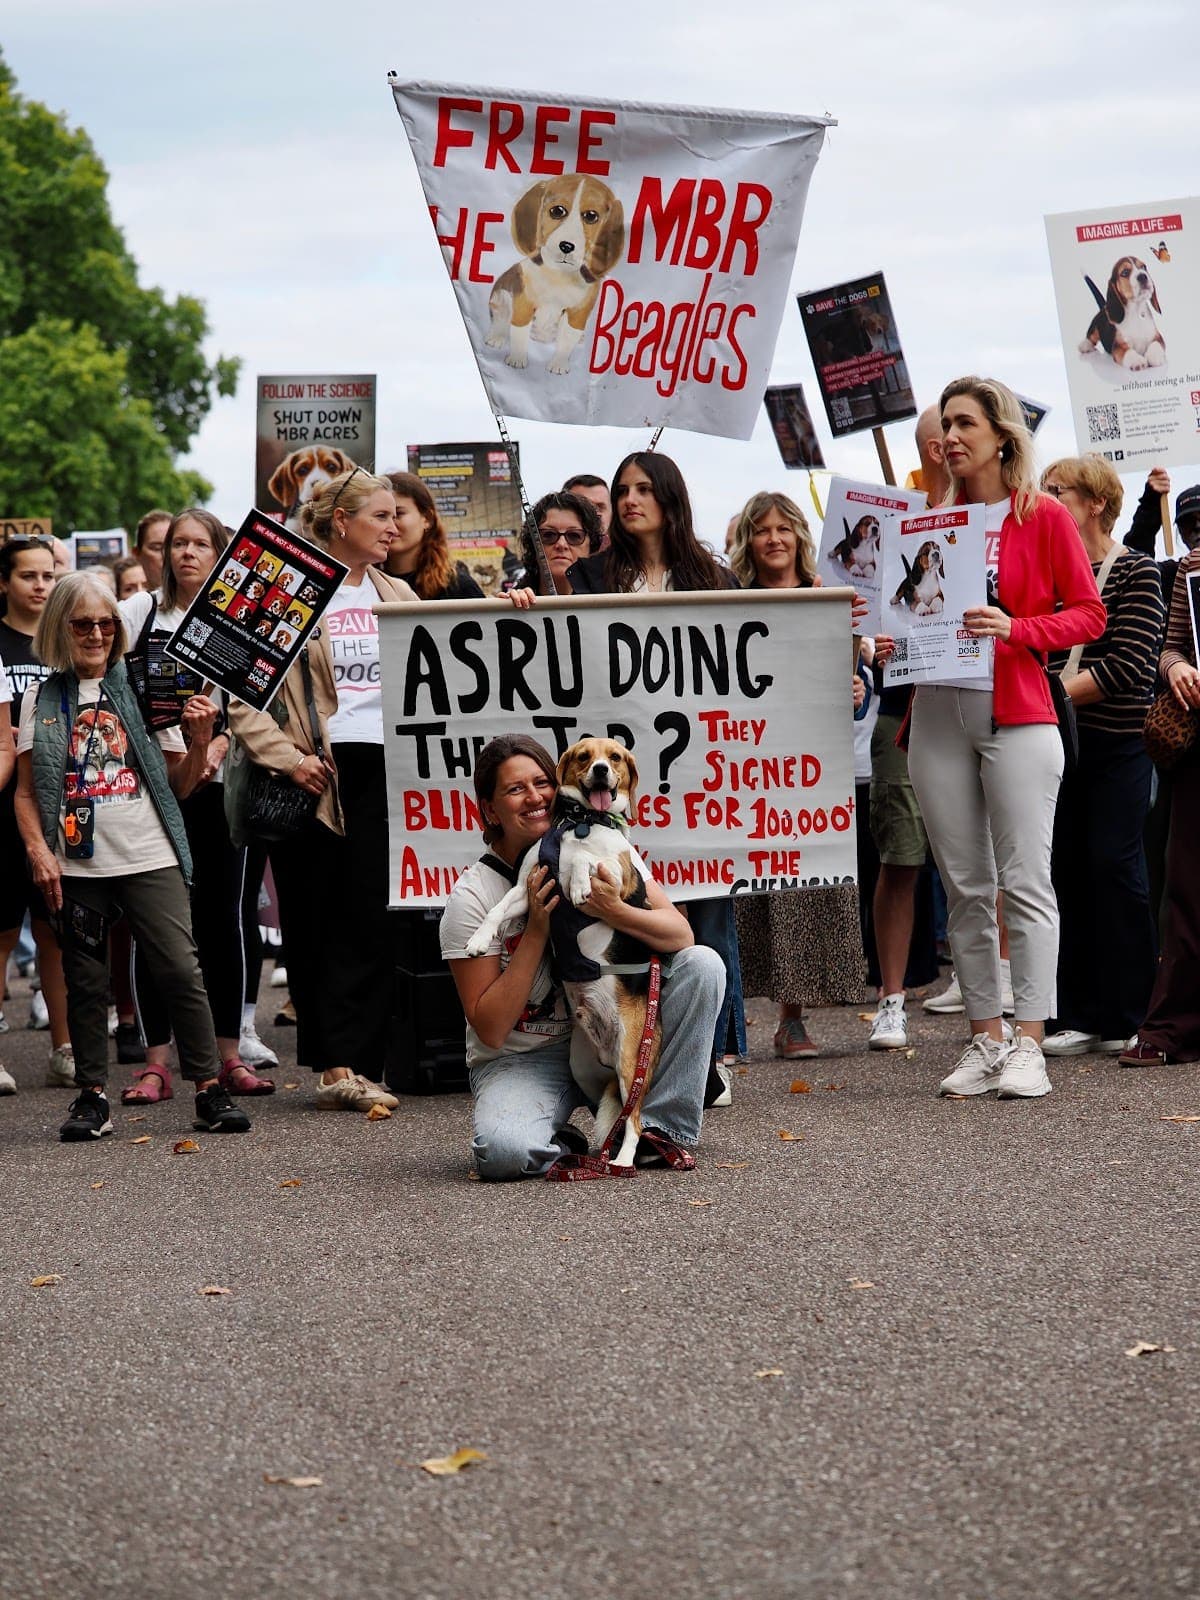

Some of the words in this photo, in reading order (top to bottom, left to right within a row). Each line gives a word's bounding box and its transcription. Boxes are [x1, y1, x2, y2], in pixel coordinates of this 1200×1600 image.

[433, 97, 615, 176] FREE
[429, 205, 504, 283] HE
[627, 176, 772, 276] MBR
[1082, 221, 1129, 239] IMAGINE
[1131, 220, 1140, 233] A
[1142, 218, 1164, 232] LIFE
[814, 299, 833, 312] SAVE
[833, 296, 847, 305] THE
[847, 290, 867, 301] DOGS
[589, 273, 755, 397] Beagles
[262, 384, 304, 399] FOLLOW
[307, 383, 326, 398] THE
[329, 382, 372, 398] SCIENCE
[1122, 379, 1152, 391] without
[1154, 376, 1178, 387] seeing
[273, 410, 313, 425] SHUT
[318, 406, 362, 424] DOWN
[277, 426, 309, 441] MBR
[313, 425, 359, 441] ACRES
[849, 492, 878, 505] IMAGINE
[878, 498, 884, 506] A
[884, 499, 898, 509] LIFE
[904, 518, 934, 531] IMAGINE
[934, 518, 940, 526] A
[940, 515, 956, 526] LIFE
[274, 536, 287, 547] NOT
[285, 543, 301, 555] JUST
[331, 639, 372, 658] THE
[958, 646, 980, 655] DOGS
[12, 664, 41, 675] TESTING
[252, 666, 264, 678] THE
[255, 659, 276, 675] SAVE
[334, 661, 381, 683] DOG
[403, 615, 584, 716] ASRU
[608, 621, 773, 698] DOING
[248, 672, 269, 689] DOGS
[699, 711, 766, 746] THEY
[702, 751, 822, 791] SIGNED
[684, 793, 743, 830] FOR
[747, 850, 801, 877] THE
